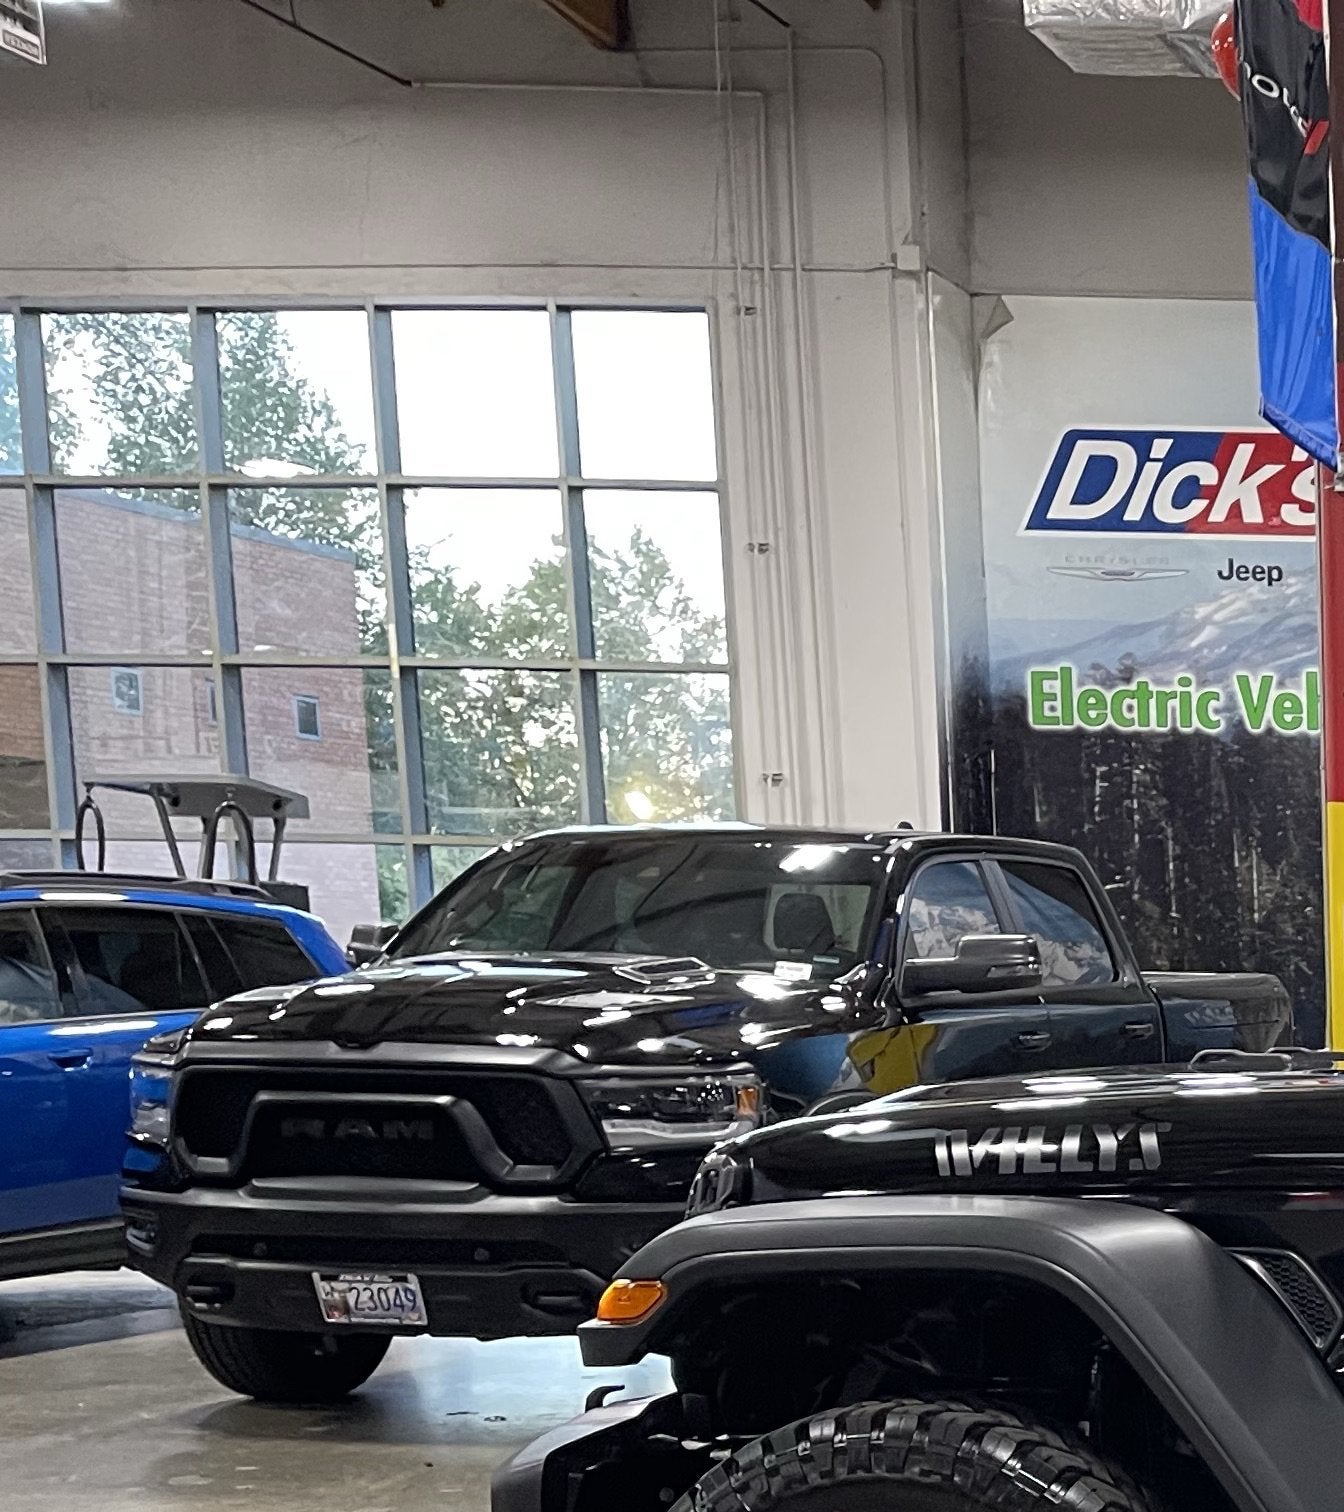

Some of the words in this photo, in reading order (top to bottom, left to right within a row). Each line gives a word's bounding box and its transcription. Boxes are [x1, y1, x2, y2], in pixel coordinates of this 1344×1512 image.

[1046, 438, 1317, 526] Dick's
[1216, 558, 1284, 587] Jeep
[1030, 666, 1222, 730] Electric
[280, 1118, 435, 1140] RAM
[935, 1122, 1172, 1177] WILLYS
[348, 1286, 417, 1313] 23049
